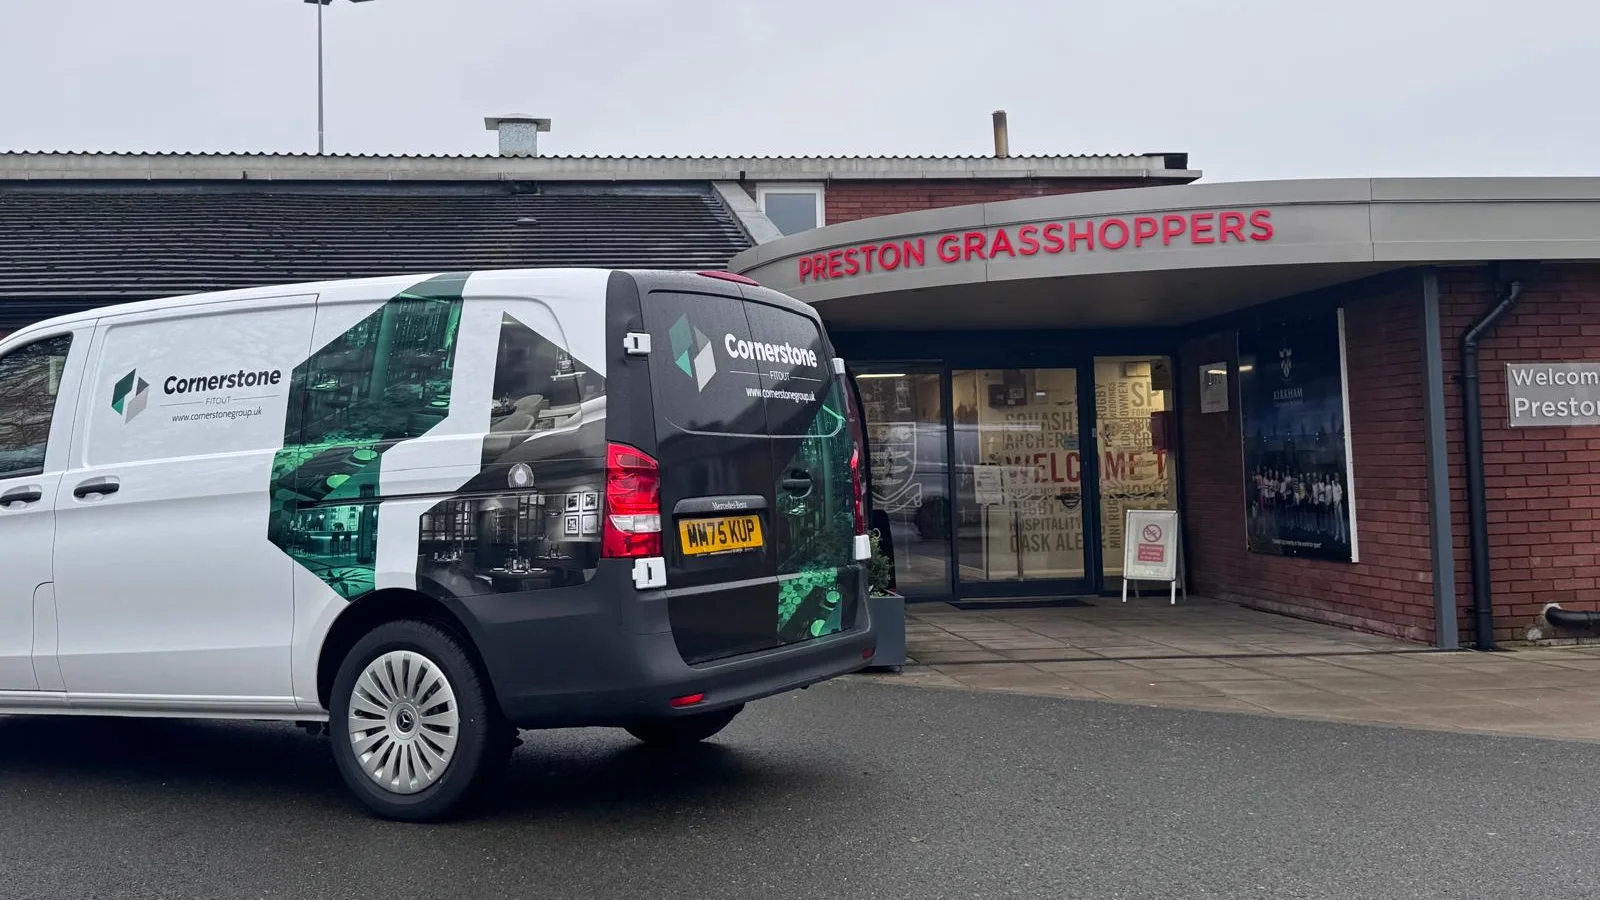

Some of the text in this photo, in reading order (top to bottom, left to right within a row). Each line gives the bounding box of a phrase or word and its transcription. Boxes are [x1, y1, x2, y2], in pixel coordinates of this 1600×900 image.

[799, 209, 1275, 283] PRESTON GRASSHOPPERS
[724, 333, 818, 368] Cornerstone
[163, 369, 282, 395] Cornerstone
[769, 370, 790, 382] FITOUT
[1511, 367, 1600, 386] Welcom
[205, 396, 232, 406] FITOUT
[745, 387, 817, 403] www.cornerstonegroup.uk
[1273, 385, 1303, 400] KIRKHAM
[171, 406, 263, 422] www.cornerstonegroup.uk
[1006, 412, 1073, 432] SQUASH
[1006, 432, 1072, 450] ARCHER
[711, 500, 748, 510] Mercedes-Benz
[728, 519, 755, 543] KUP
